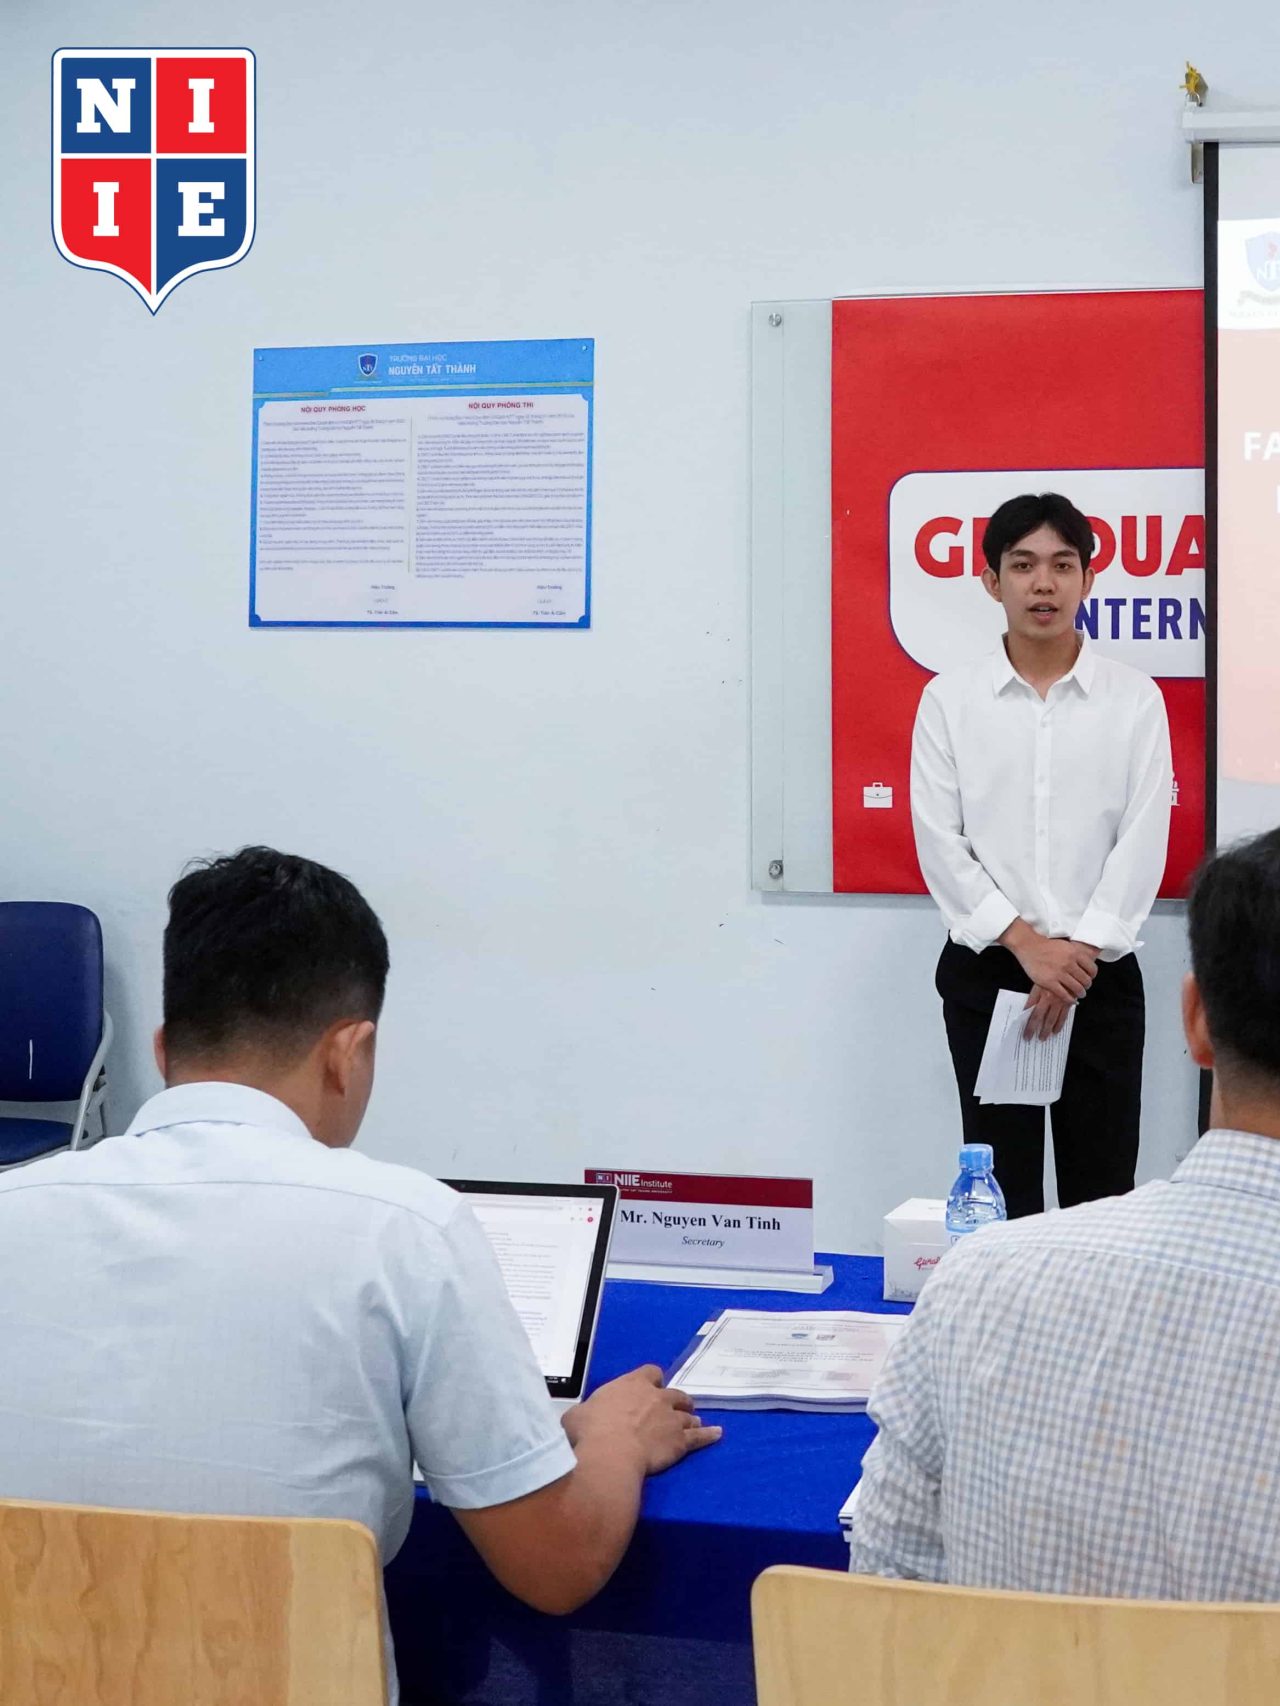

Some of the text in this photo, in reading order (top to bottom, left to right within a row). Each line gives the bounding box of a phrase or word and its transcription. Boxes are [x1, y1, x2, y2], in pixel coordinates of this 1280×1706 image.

[614, 1173, 641, 1187] NIIE
[641, 1179, 673, 1188] Institute
[620, 1210, 781, 1231] Mr. Nguyen Van Tinh
[681, 1235, 726, 1249] Secretary
